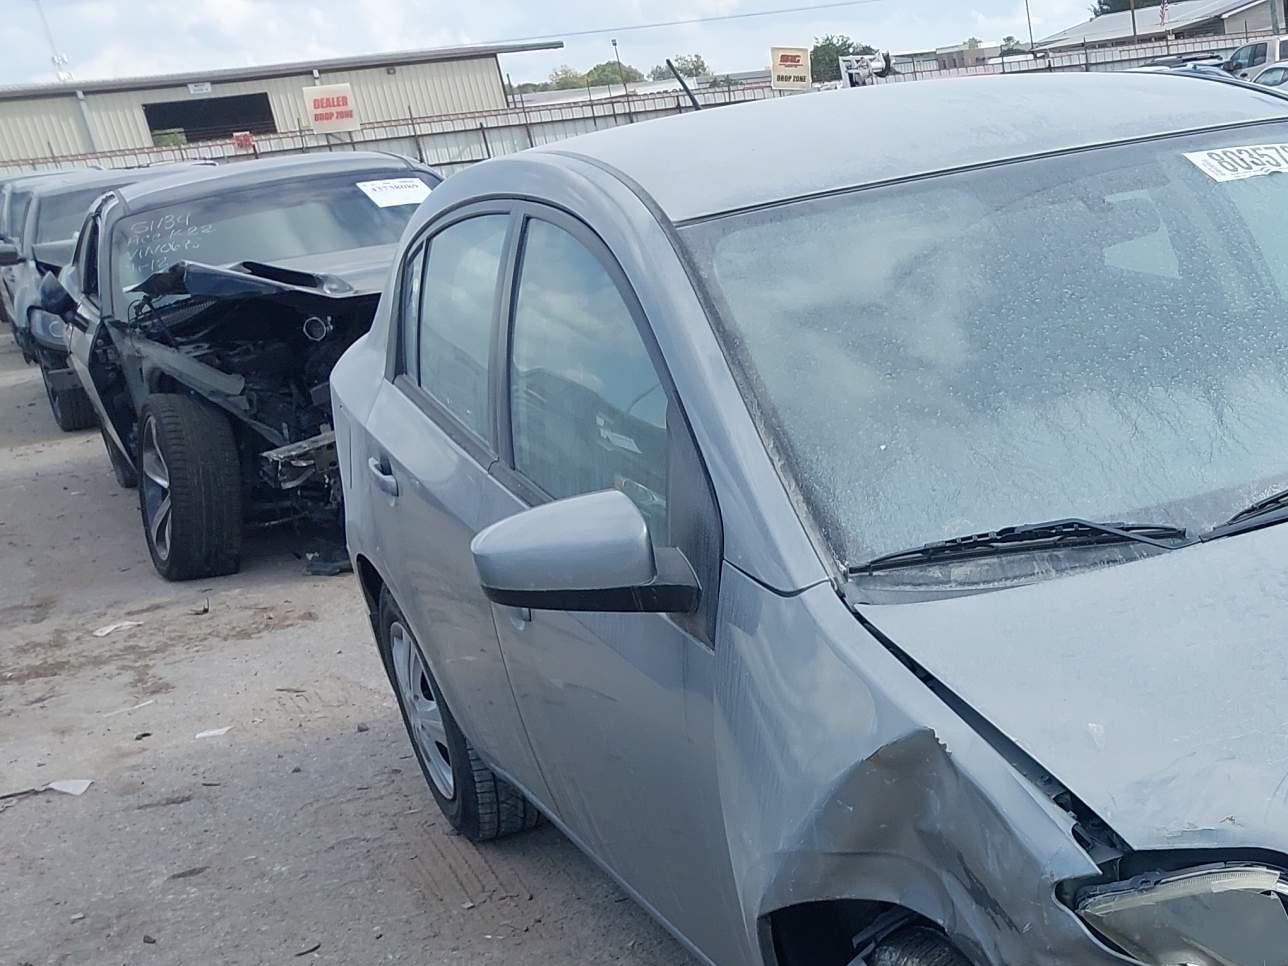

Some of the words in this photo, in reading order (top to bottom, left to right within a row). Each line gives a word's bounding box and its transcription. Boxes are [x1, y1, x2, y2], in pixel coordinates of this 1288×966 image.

[313, 96, 348, 109] DEALER
[314, 112, 334, 121] DROP
[336, 110, 353, 119] ZONE
